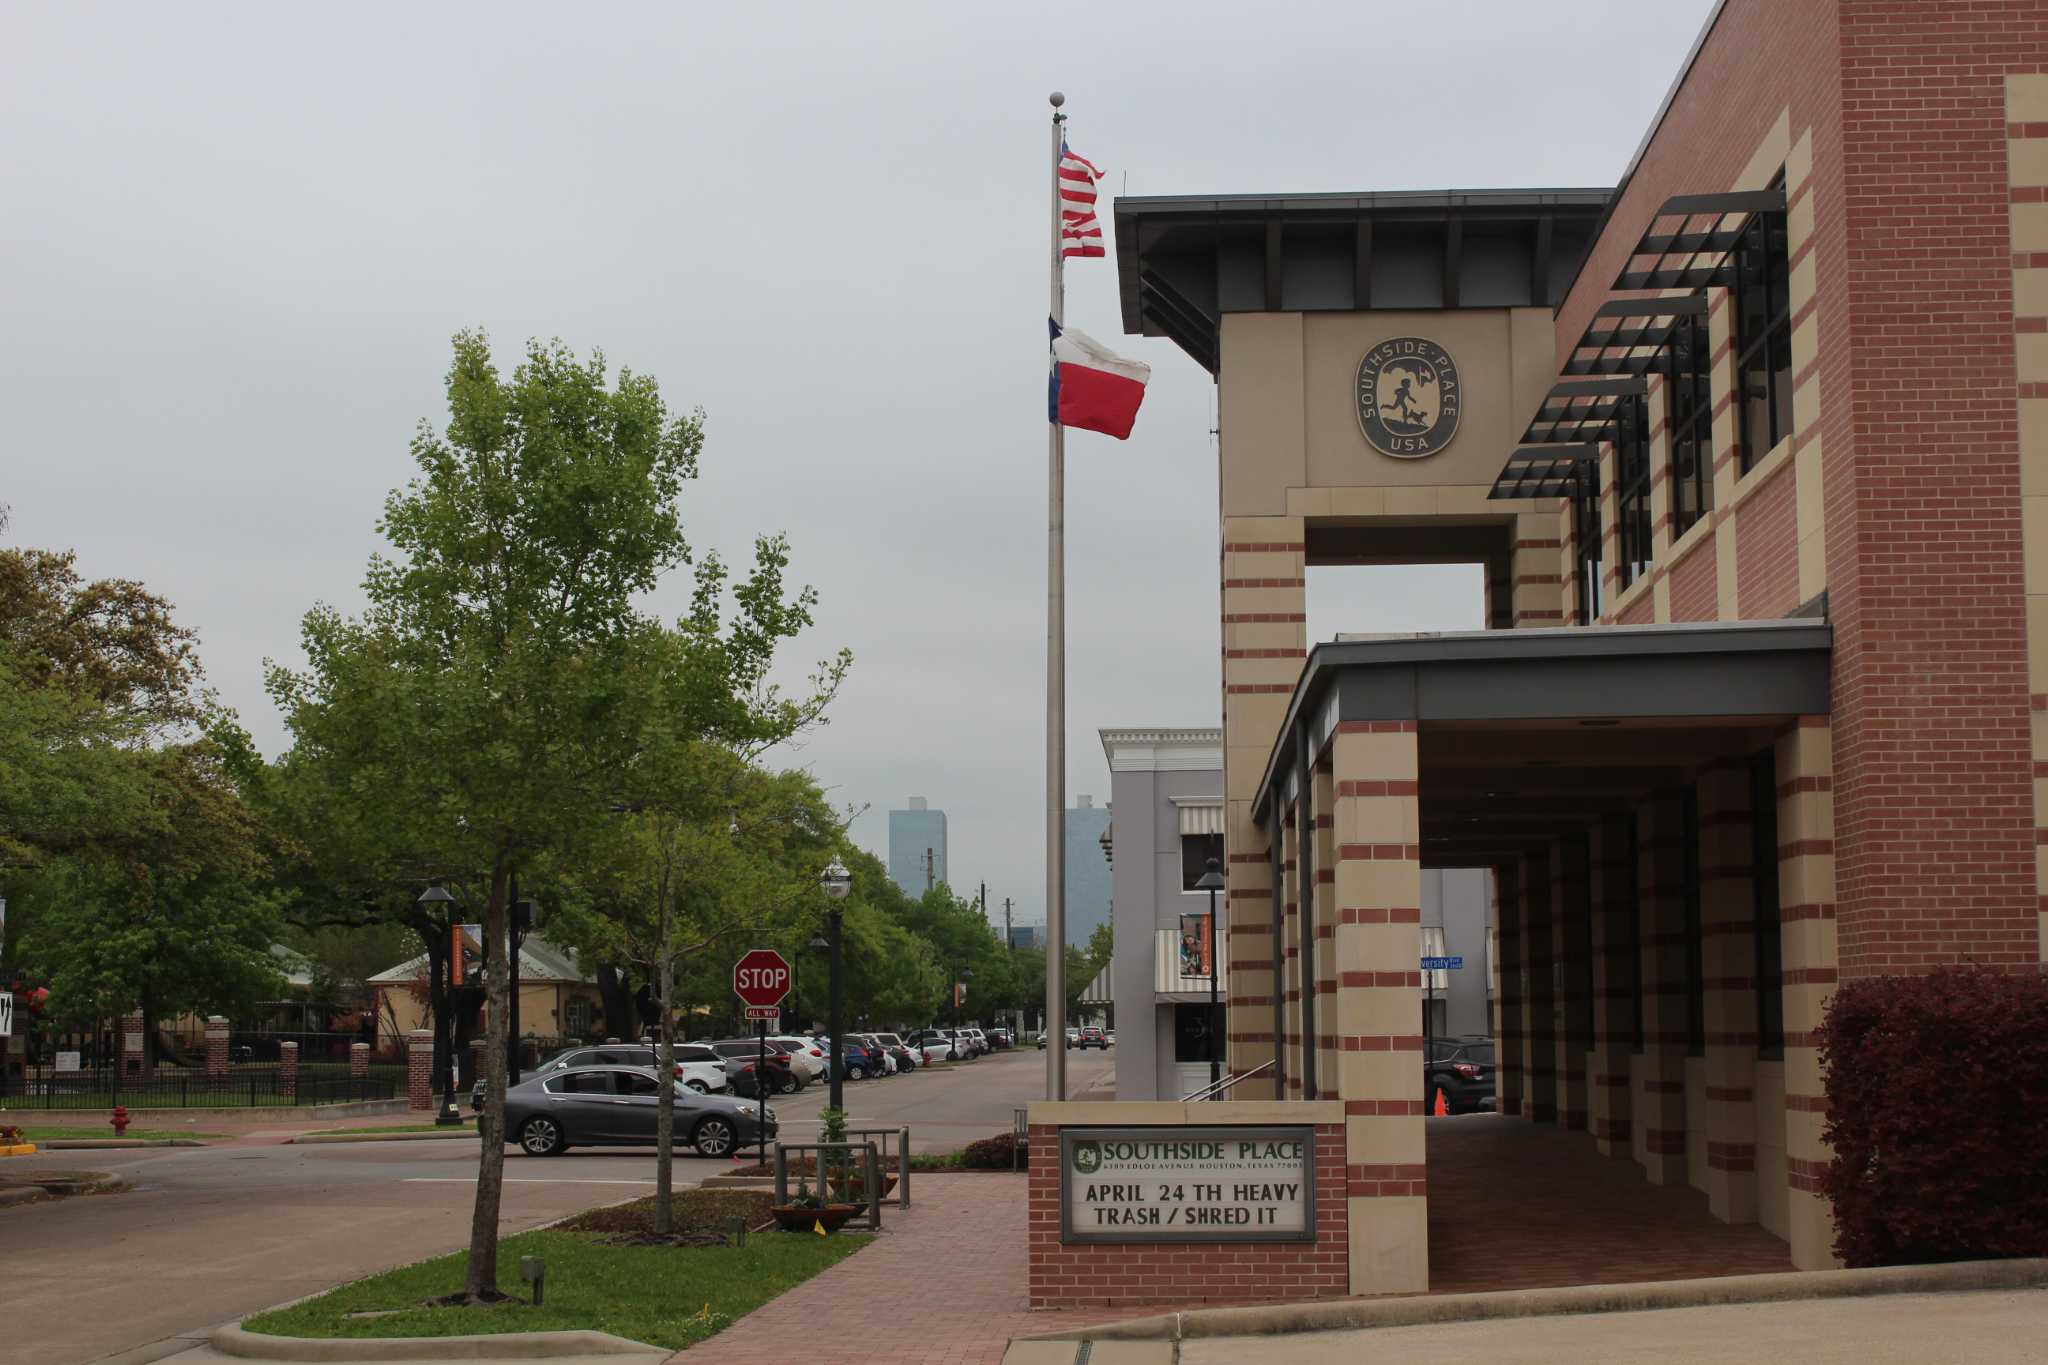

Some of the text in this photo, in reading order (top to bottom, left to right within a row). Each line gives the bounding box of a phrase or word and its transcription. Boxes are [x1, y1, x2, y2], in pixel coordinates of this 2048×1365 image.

[1361, 341, 1456, 418] SOUTHSIDE PLACE
[1391, 437, 1429, 451] USA
[738, 968, 786, 989] STOP
[1104, 1142, 1225, 1160] SOUTHSIDE
[1239, 1142, 1303, 1160] PLACE
[1086, 1184, 1298, 1201] APRIL 24 TH HEAVY
[1094, 1207, 1160, 1225] TRASH
[1185, 1207, 1250, 1225] SHRED
[1258, 1207, 1277, 1225] IT
